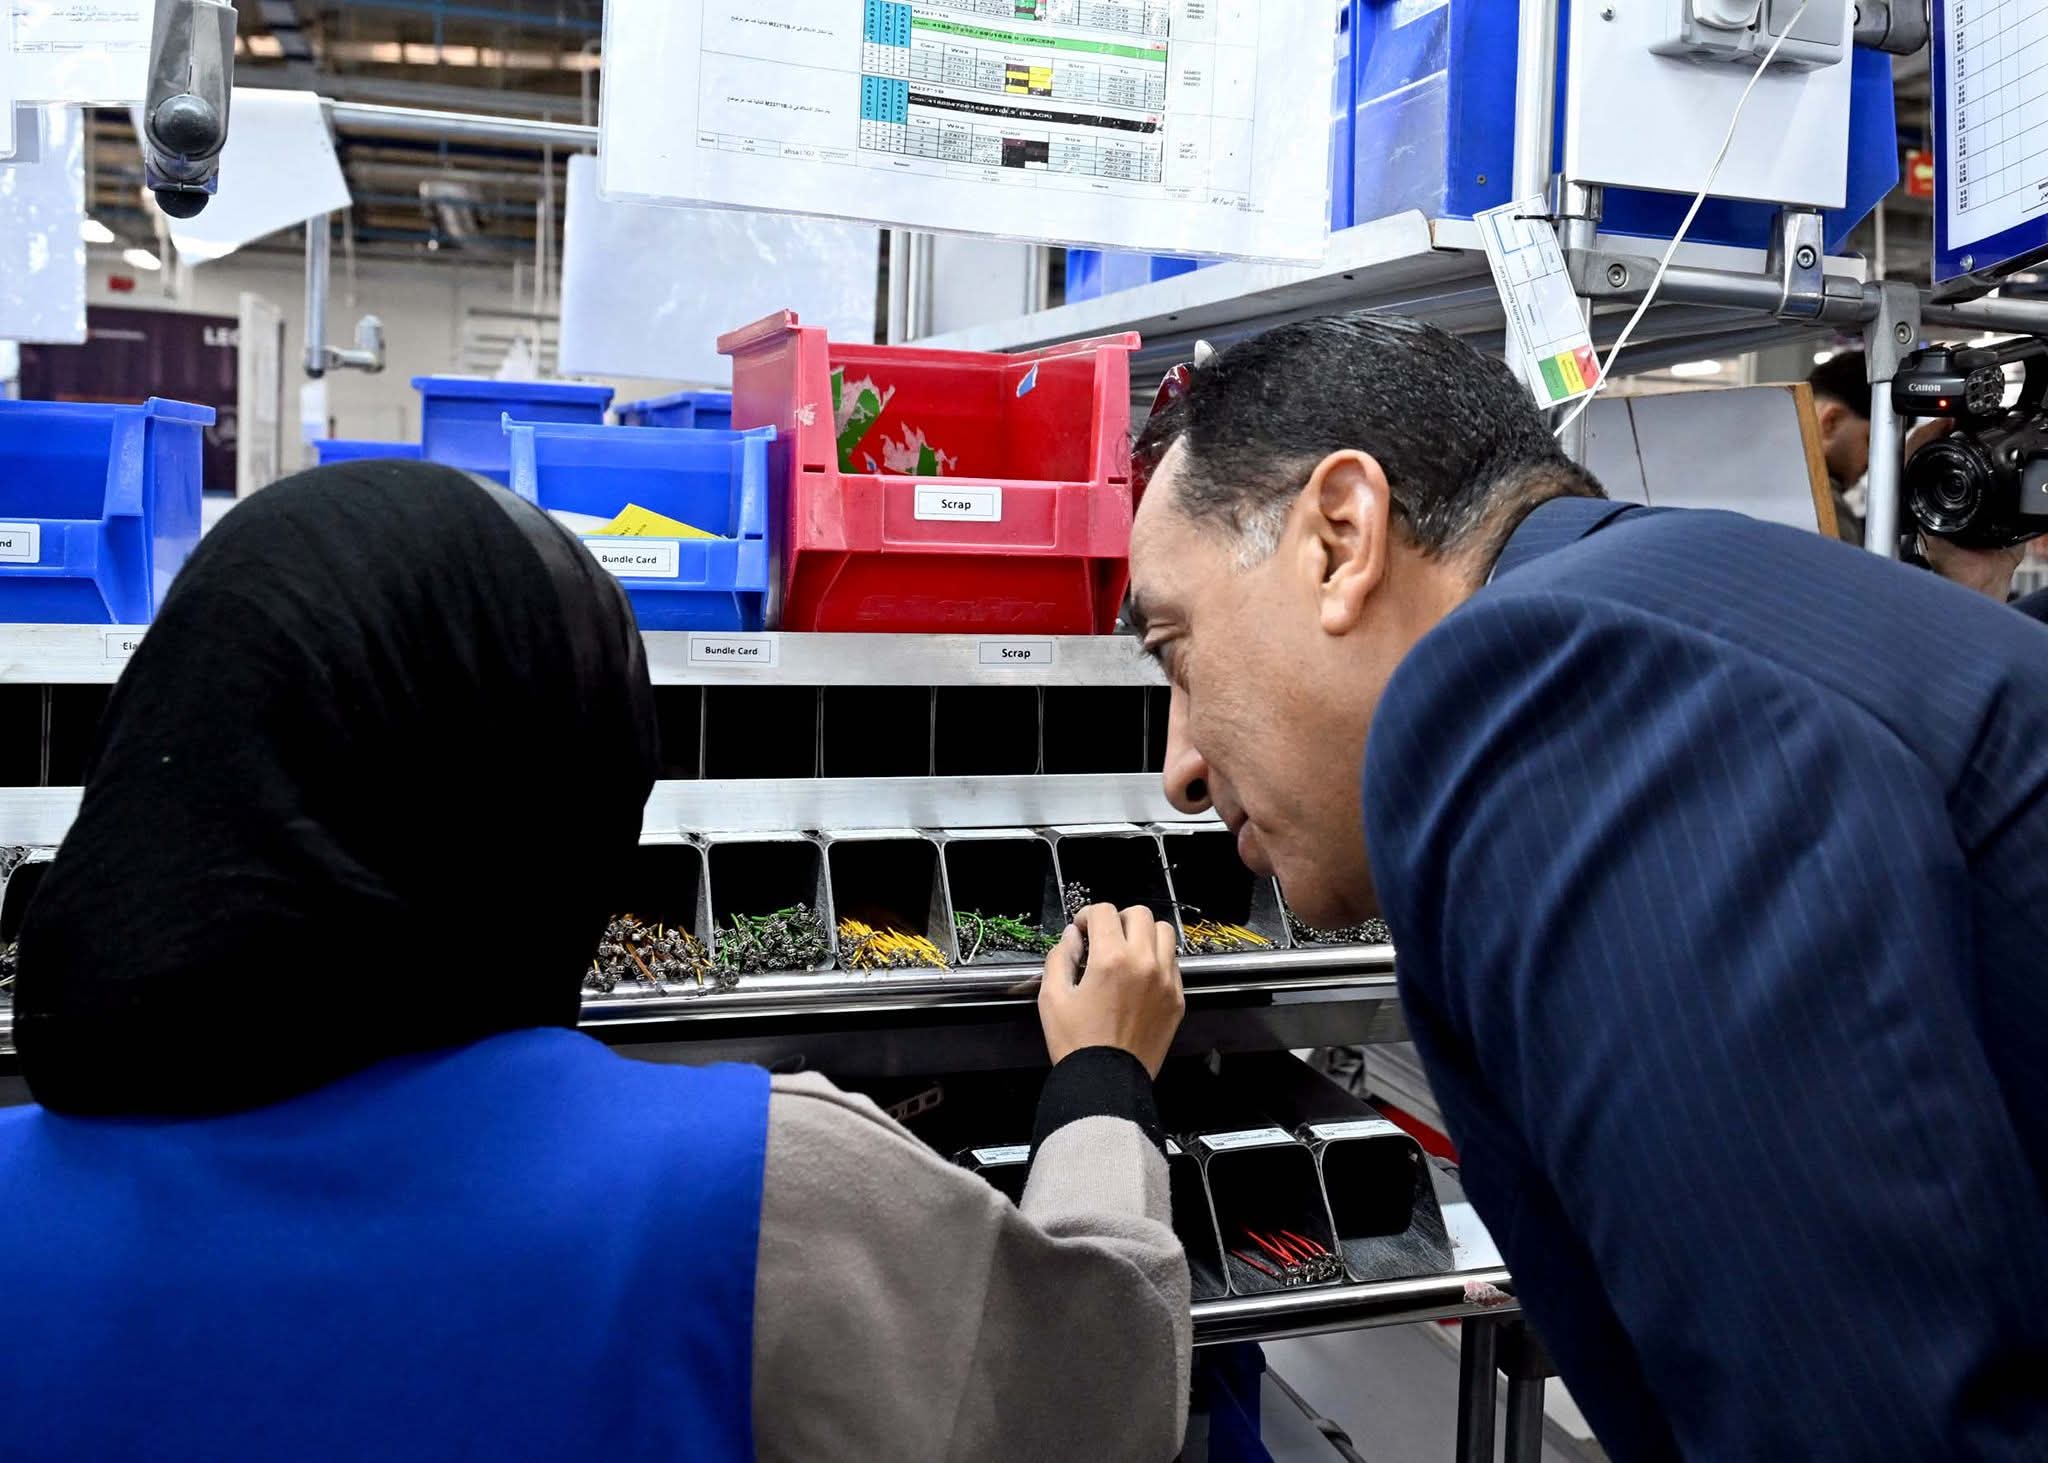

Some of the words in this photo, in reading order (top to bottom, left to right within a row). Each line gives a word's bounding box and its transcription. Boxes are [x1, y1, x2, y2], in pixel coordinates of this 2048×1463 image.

[1908, 383, 1942, 392] Canon
[941, 499, 972, 511] Scrap
[602, 555, 634, 565] Bundle
[636, 555, 657, 565] Card
[705, 646, 736, 656] Bundle
[738, 647, 758, 656] Card
[1002, 648, 1031, 660] Scrap
